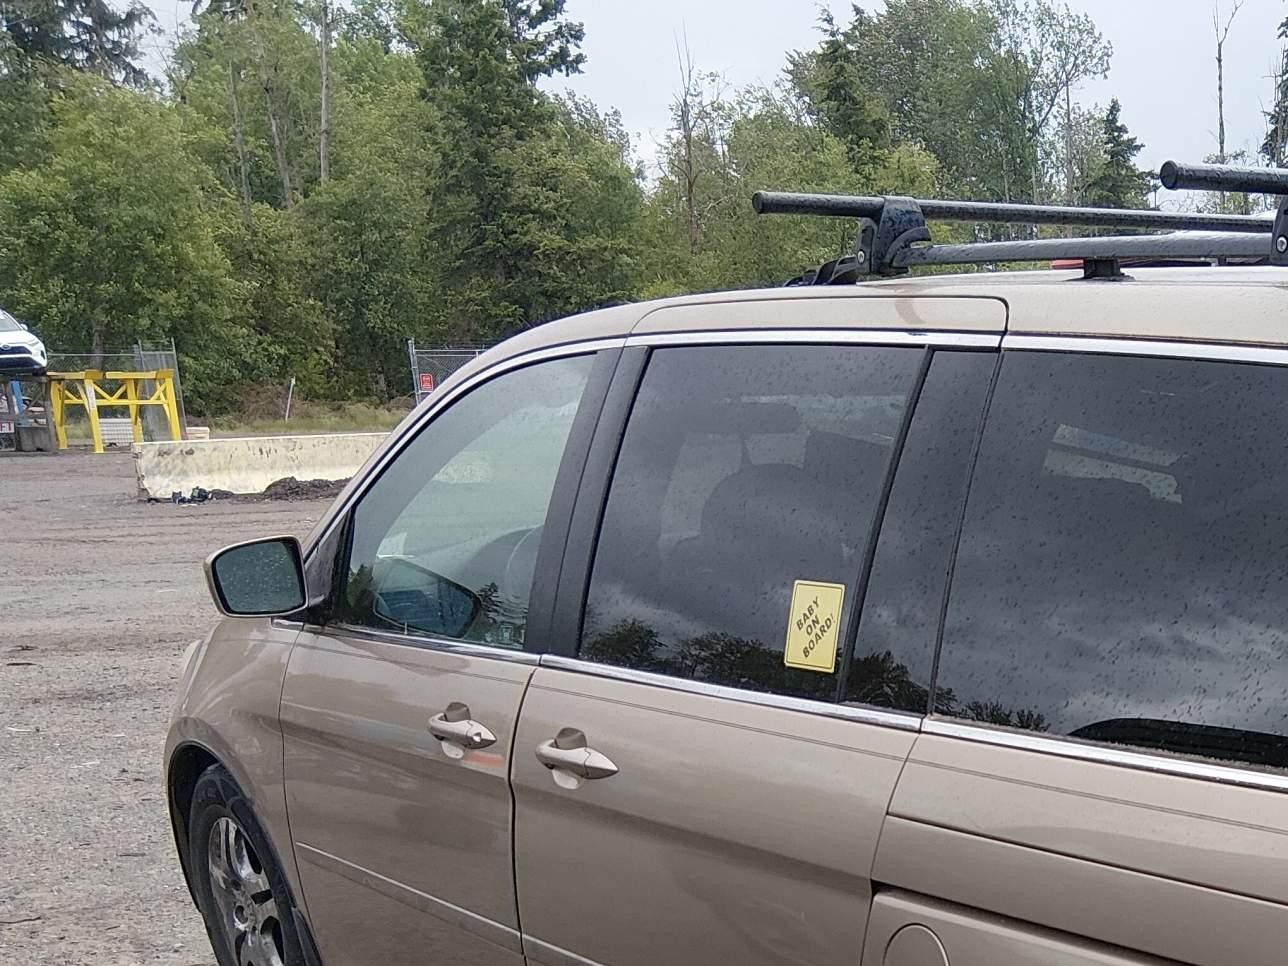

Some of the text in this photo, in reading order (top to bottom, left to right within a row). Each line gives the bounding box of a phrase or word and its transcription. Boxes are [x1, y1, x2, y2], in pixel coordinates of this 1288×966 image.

[796, 596, 819, 631] BABY
[805, 614, 820, 637] ON
[802, 613, 836, 659] BOARD!
